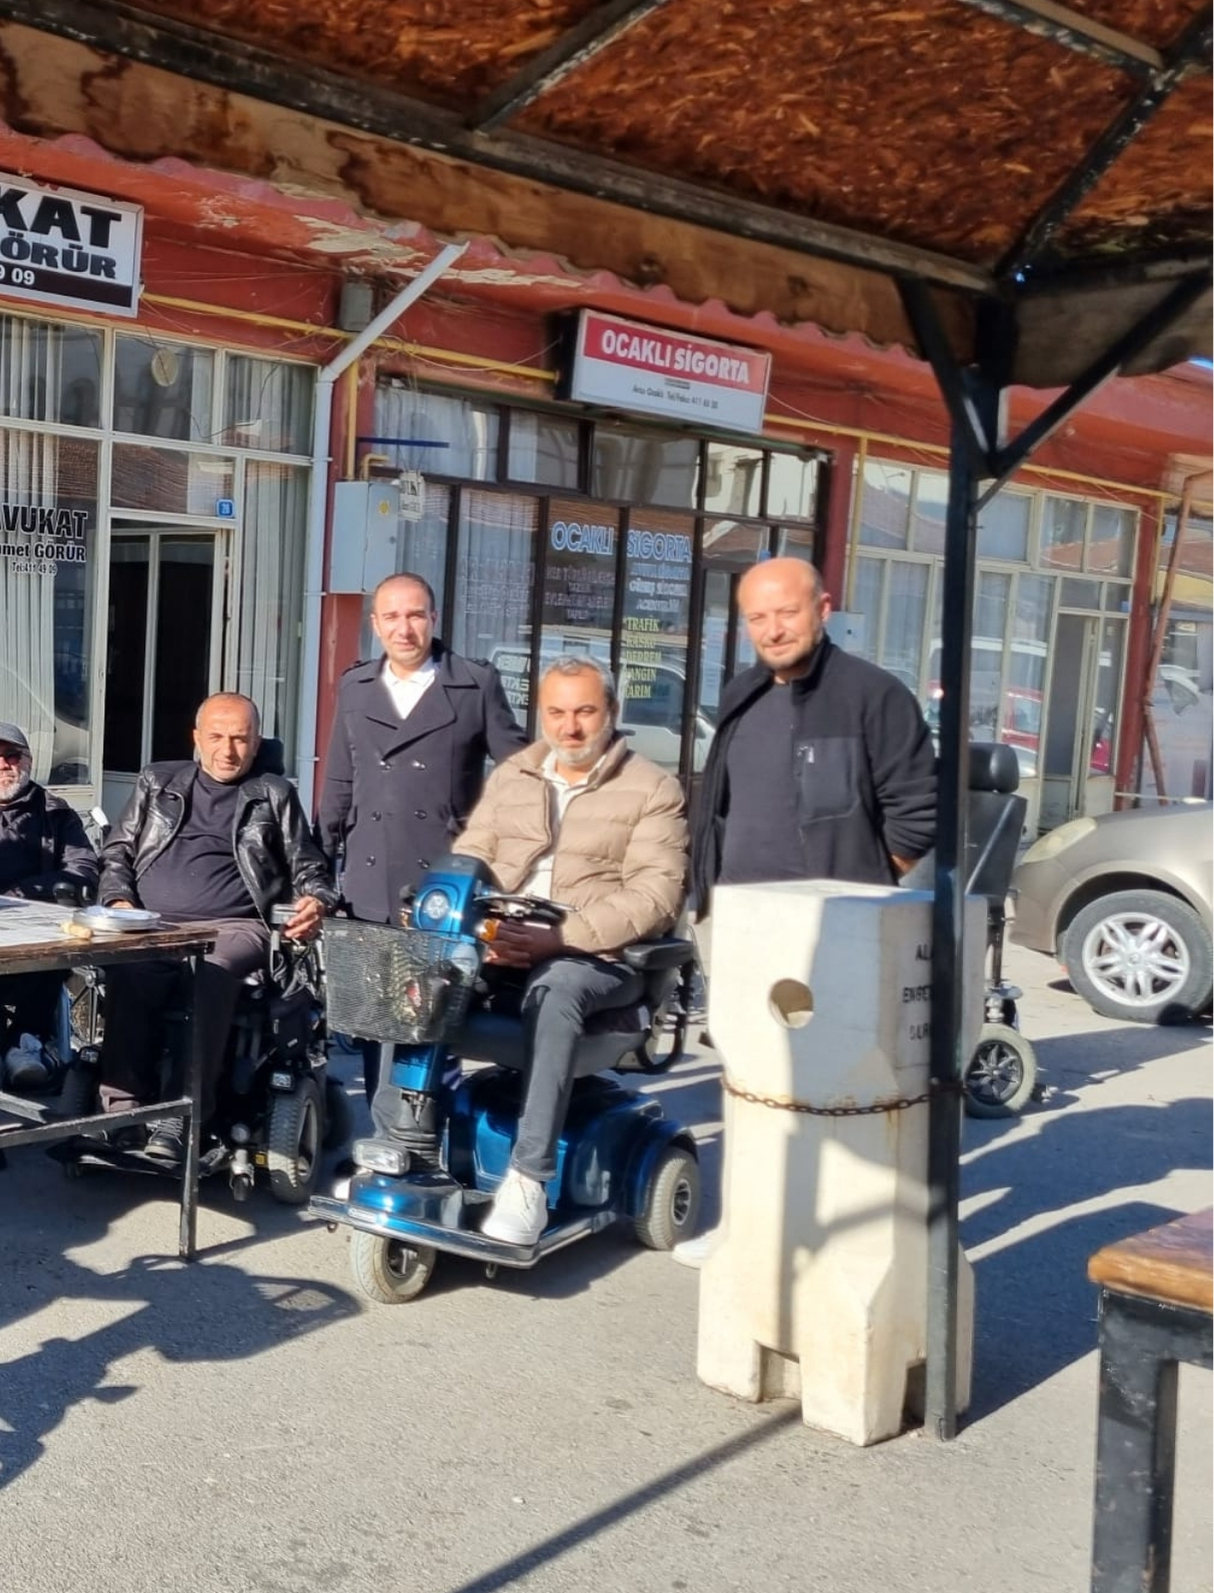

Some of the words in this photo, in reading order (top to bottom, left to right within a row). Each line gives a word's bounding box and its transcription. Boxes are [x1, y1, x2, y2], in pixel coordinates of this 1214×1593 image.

[11, 267, 35, 285] 09
[601, 329, 671, 368] OCAKLI
[674, 344, 750, 384] SİGORTA
[34, 539, 86, 562] GÖRÜR
[551, 520, 615, 556] OCAKLI
